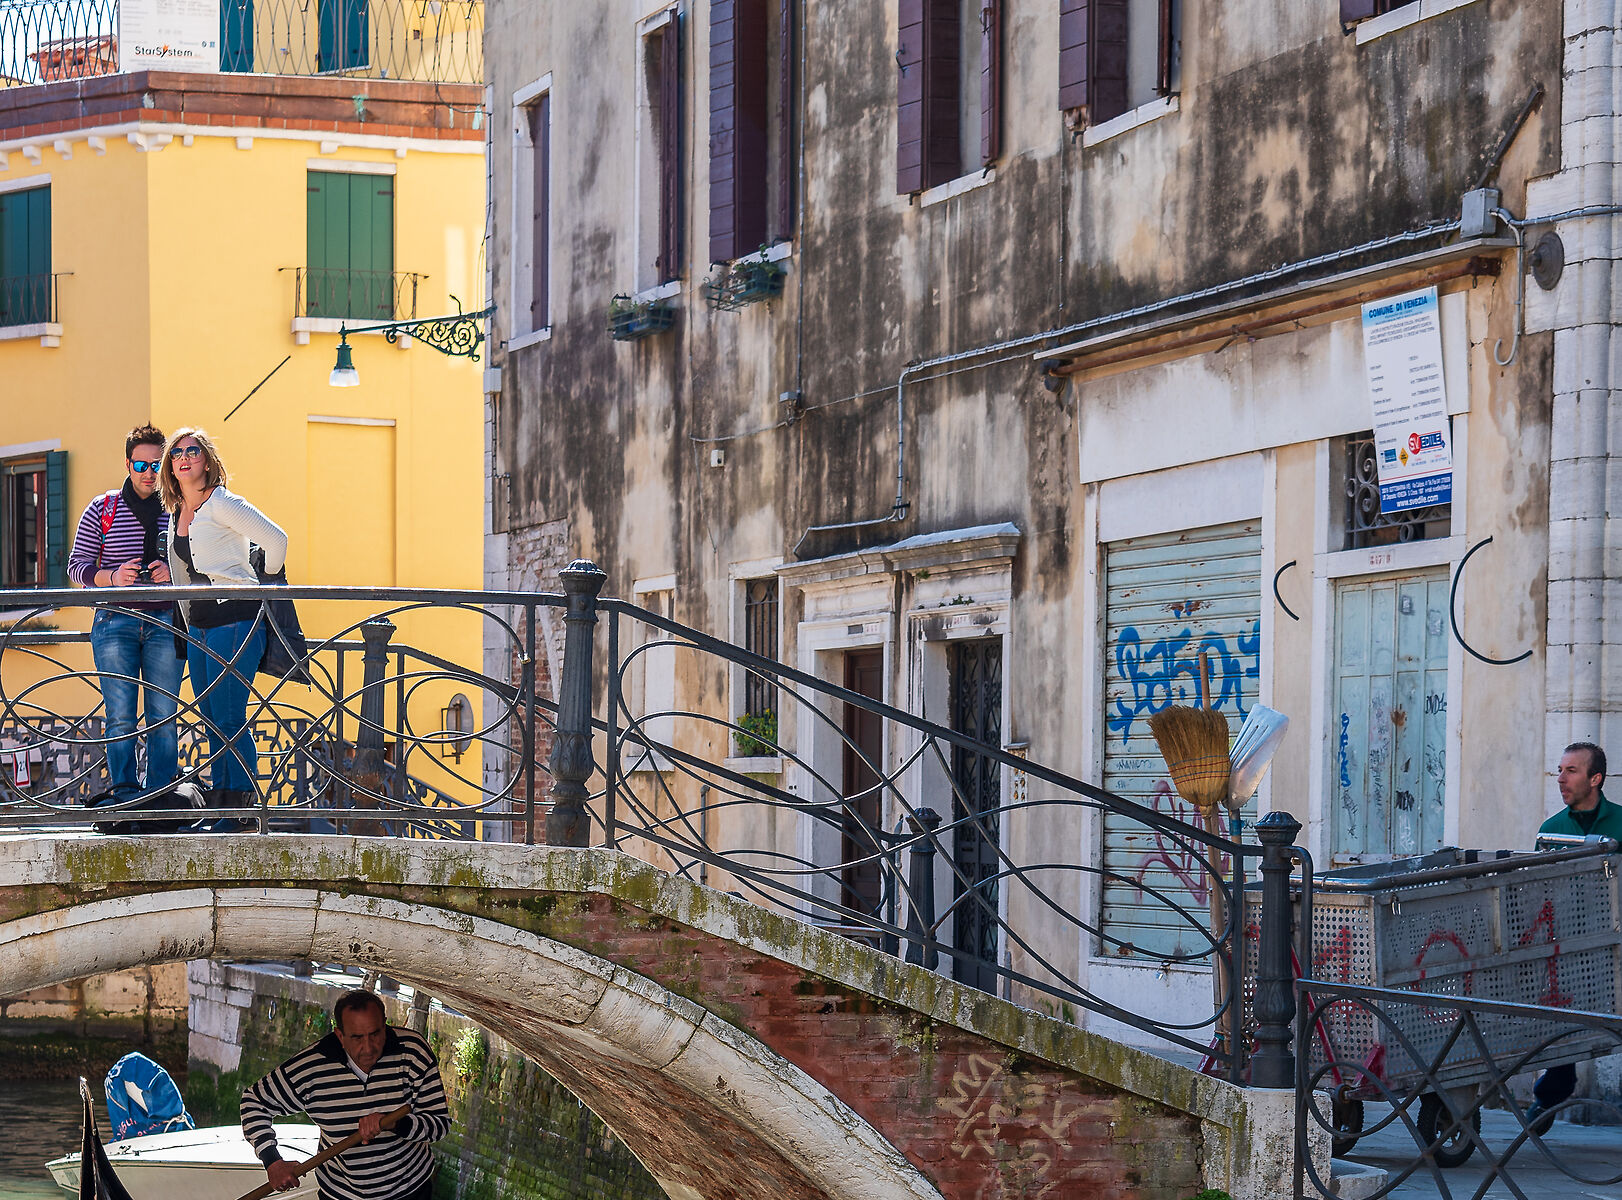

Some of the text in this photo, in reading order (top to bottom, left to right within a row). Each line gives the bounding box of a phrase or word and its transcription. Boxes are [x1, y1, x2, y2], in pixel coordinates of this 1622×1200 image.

[135, 45, 193, 58] StarSystem
[1368, 304, 1394, 318] COMUNE
[1395, 302, 1402, 311] DI
[1402, 295, 1428, 310] VENEZIA
